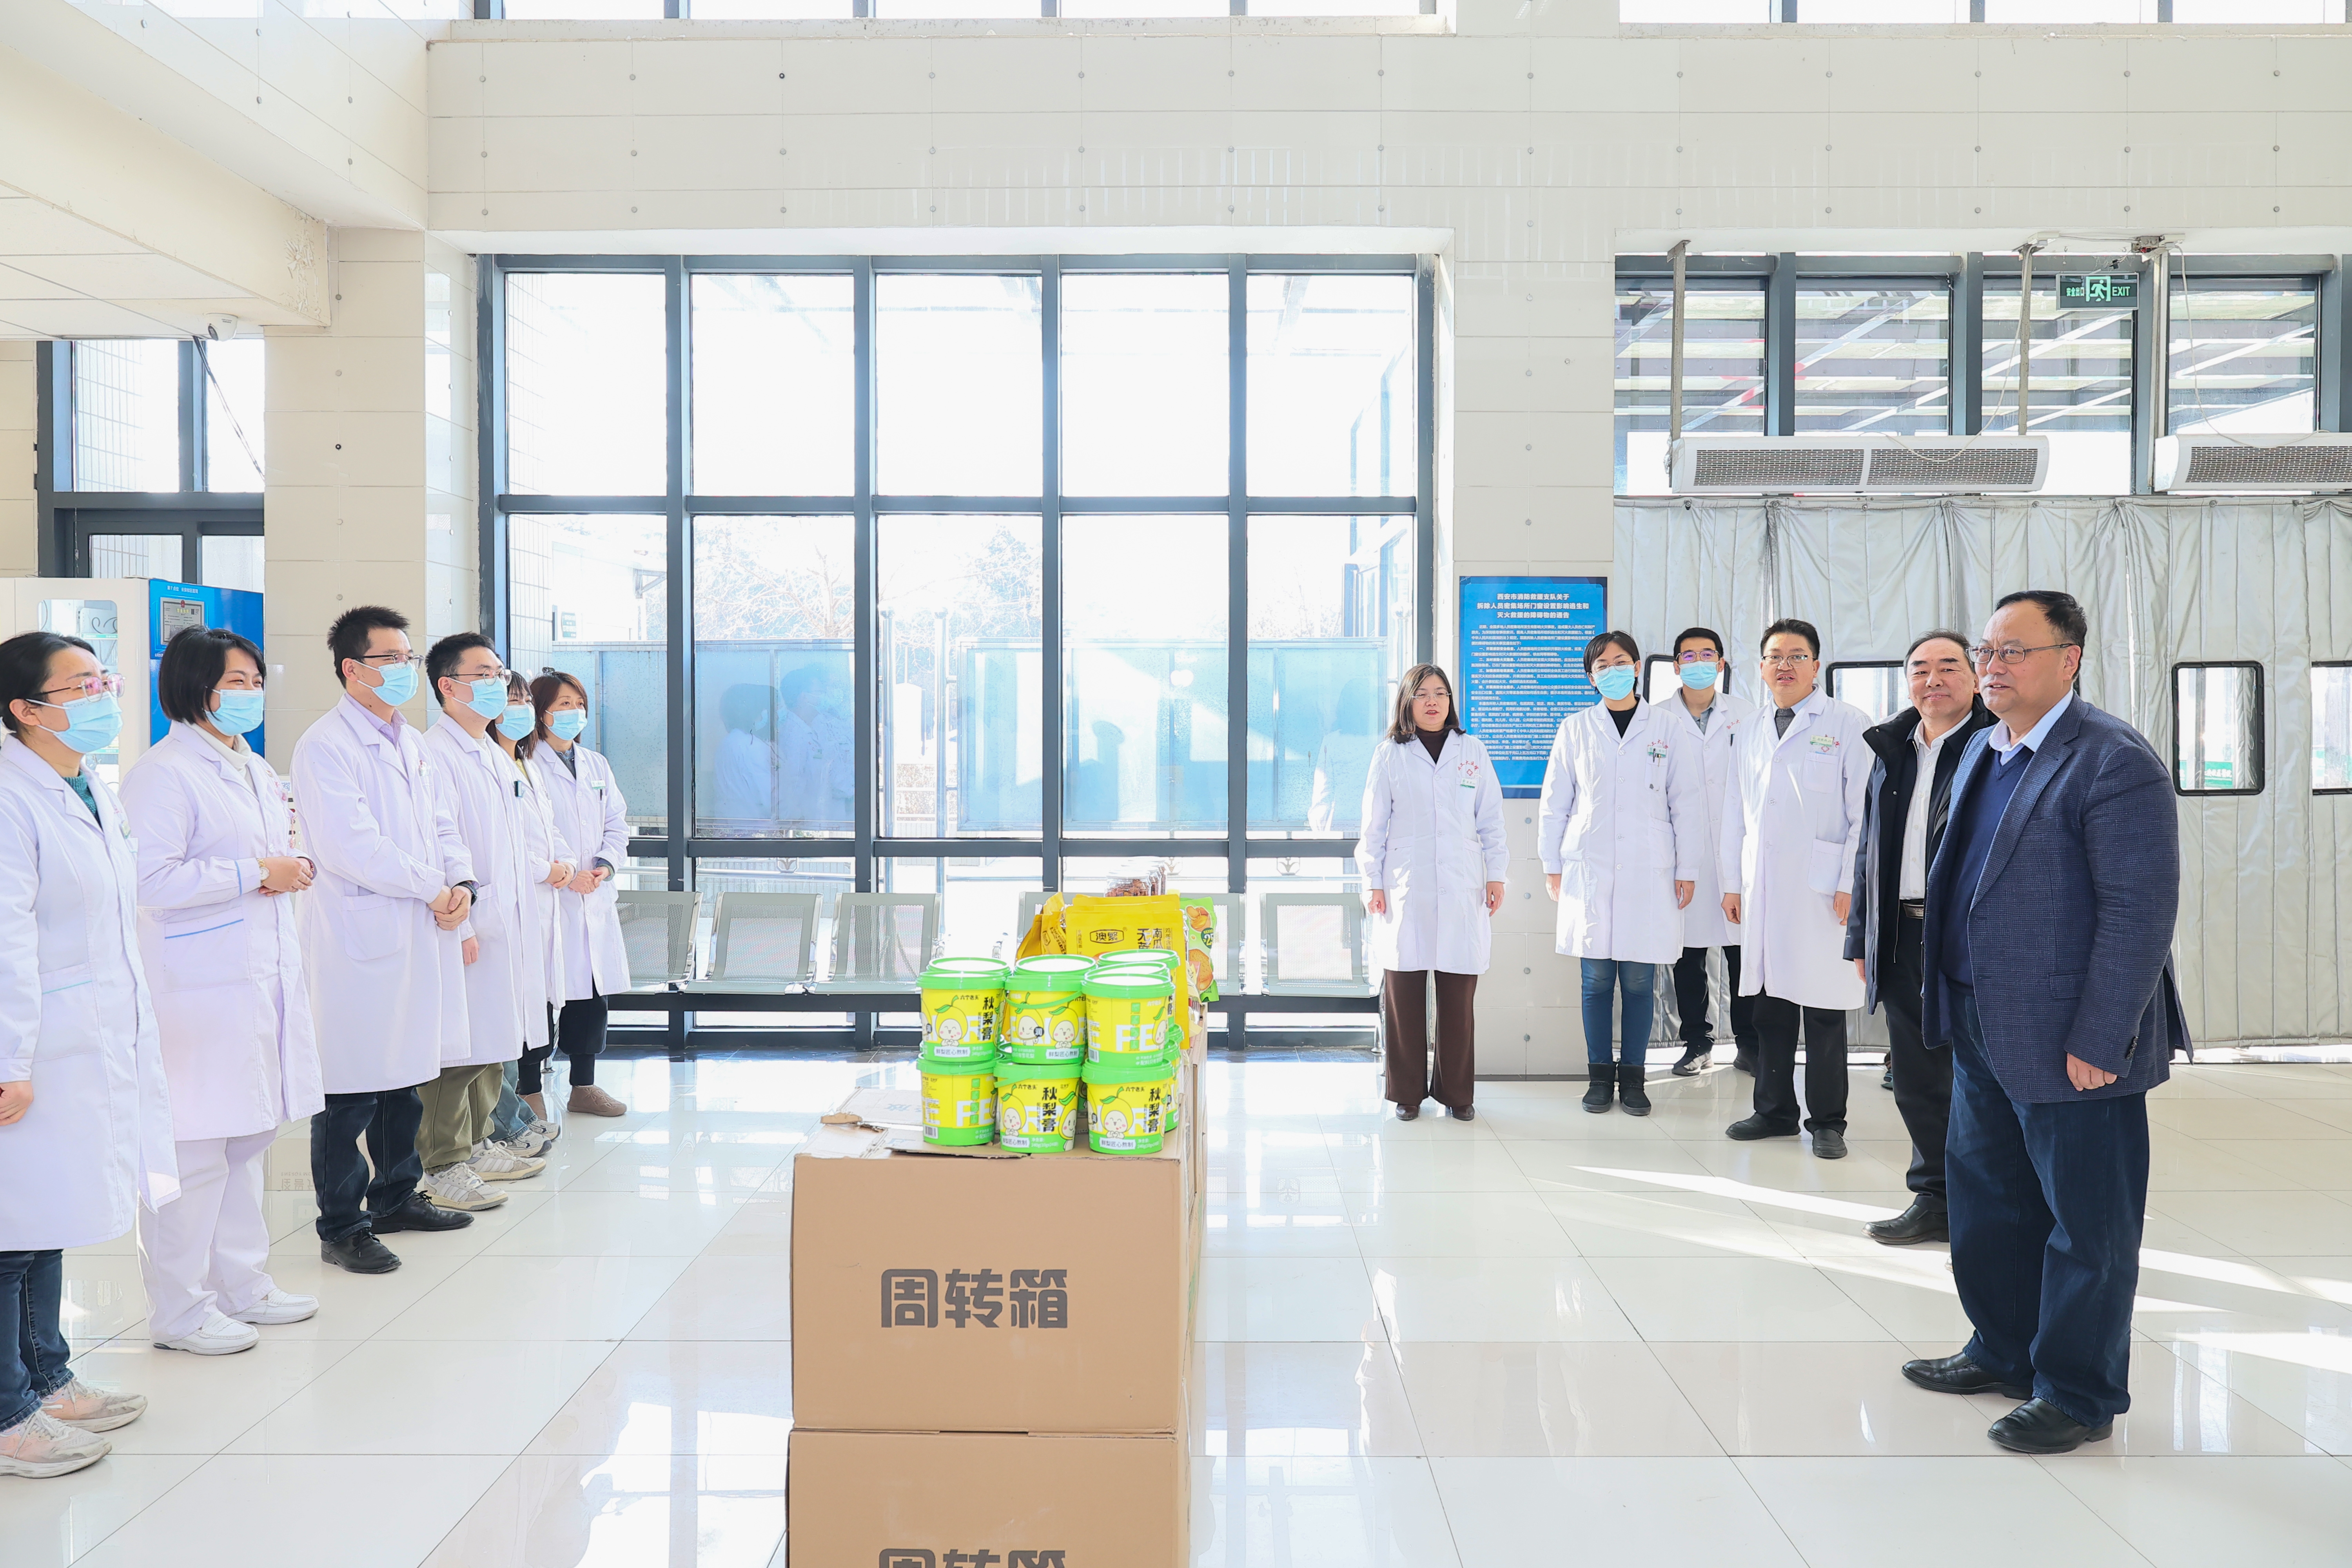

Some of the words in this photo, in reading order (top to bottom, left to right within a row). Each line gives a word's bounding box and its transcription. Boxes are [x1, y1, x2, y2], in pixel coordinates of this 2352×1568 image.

[2066, 287, 2084, 296] 安全出口
[2112, 286, 2131, 296] EXIT
[1096, 932, 1118, 941] 澳繁
[1152, 928, 1163, 949] 南瓜
[982, 997, 995, 1040] 秋梨膏
[1042, 1087, 1057, 1132] 秋梨膏
[1147, 1087, 1161, 1133] 秋梨膏
[880, 1269, 1068, 1328] 周转箱
